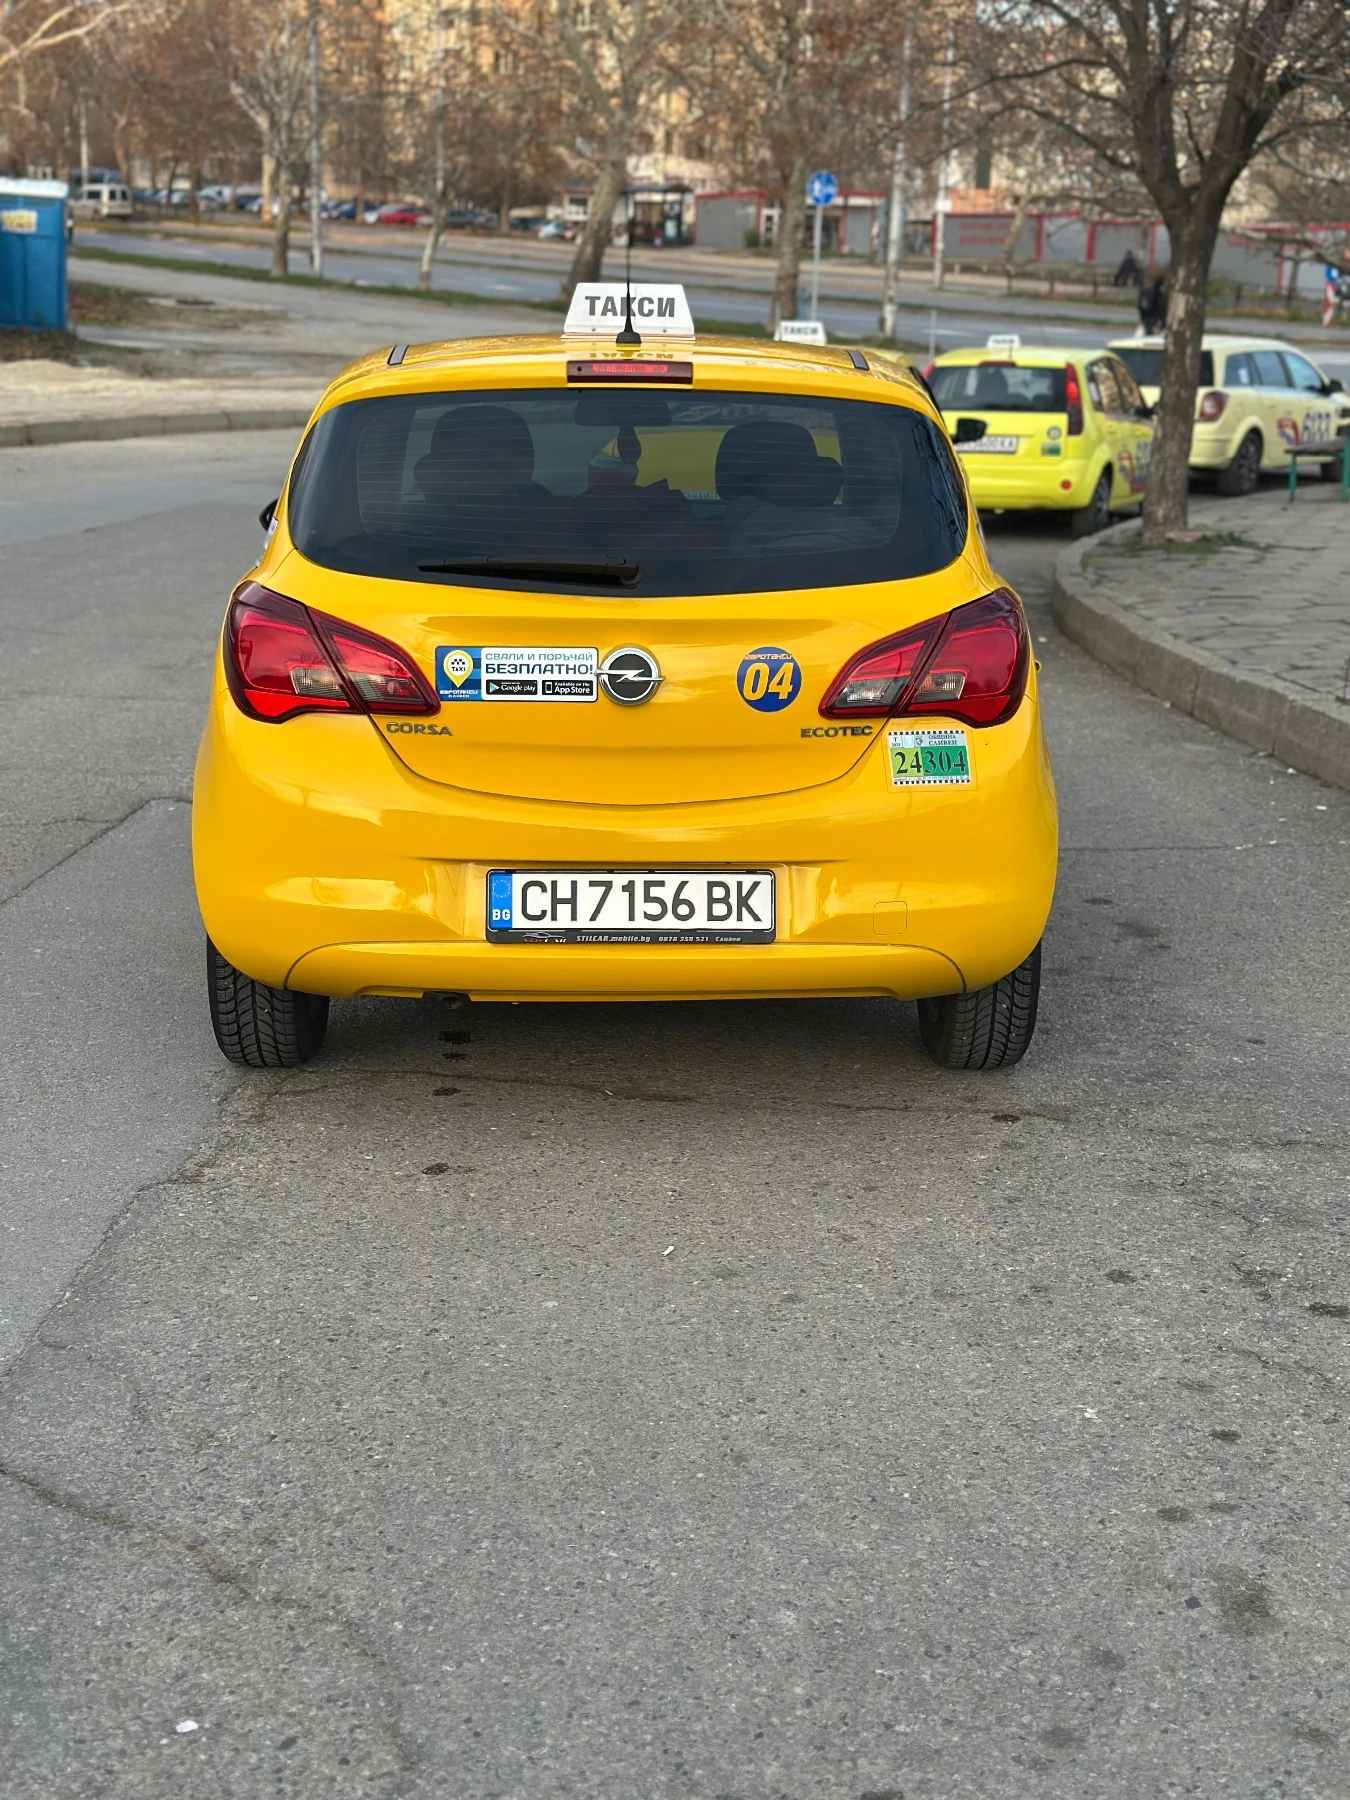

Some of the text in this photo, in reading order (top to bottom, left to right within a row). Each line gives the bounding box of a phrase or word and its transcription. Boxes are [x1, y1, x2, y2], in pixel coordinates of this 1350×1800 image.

[584, 296, 675, 317] ТАКСИ
[539, 652, 593, 660] ПОРЪЧАЙ
[485, 663, 593, 674] БЕЗПЛАТНО!
[743, 662, 794, 700] 04
[386, 721, 453, 736] CORSA
[801, 725, 873, 738] ECOTEC
[894, 750, 966, 774] 24304
[492, 909, 511, 920] BG
[576, 935, 651, 943] STILCAR.mobile.bg
